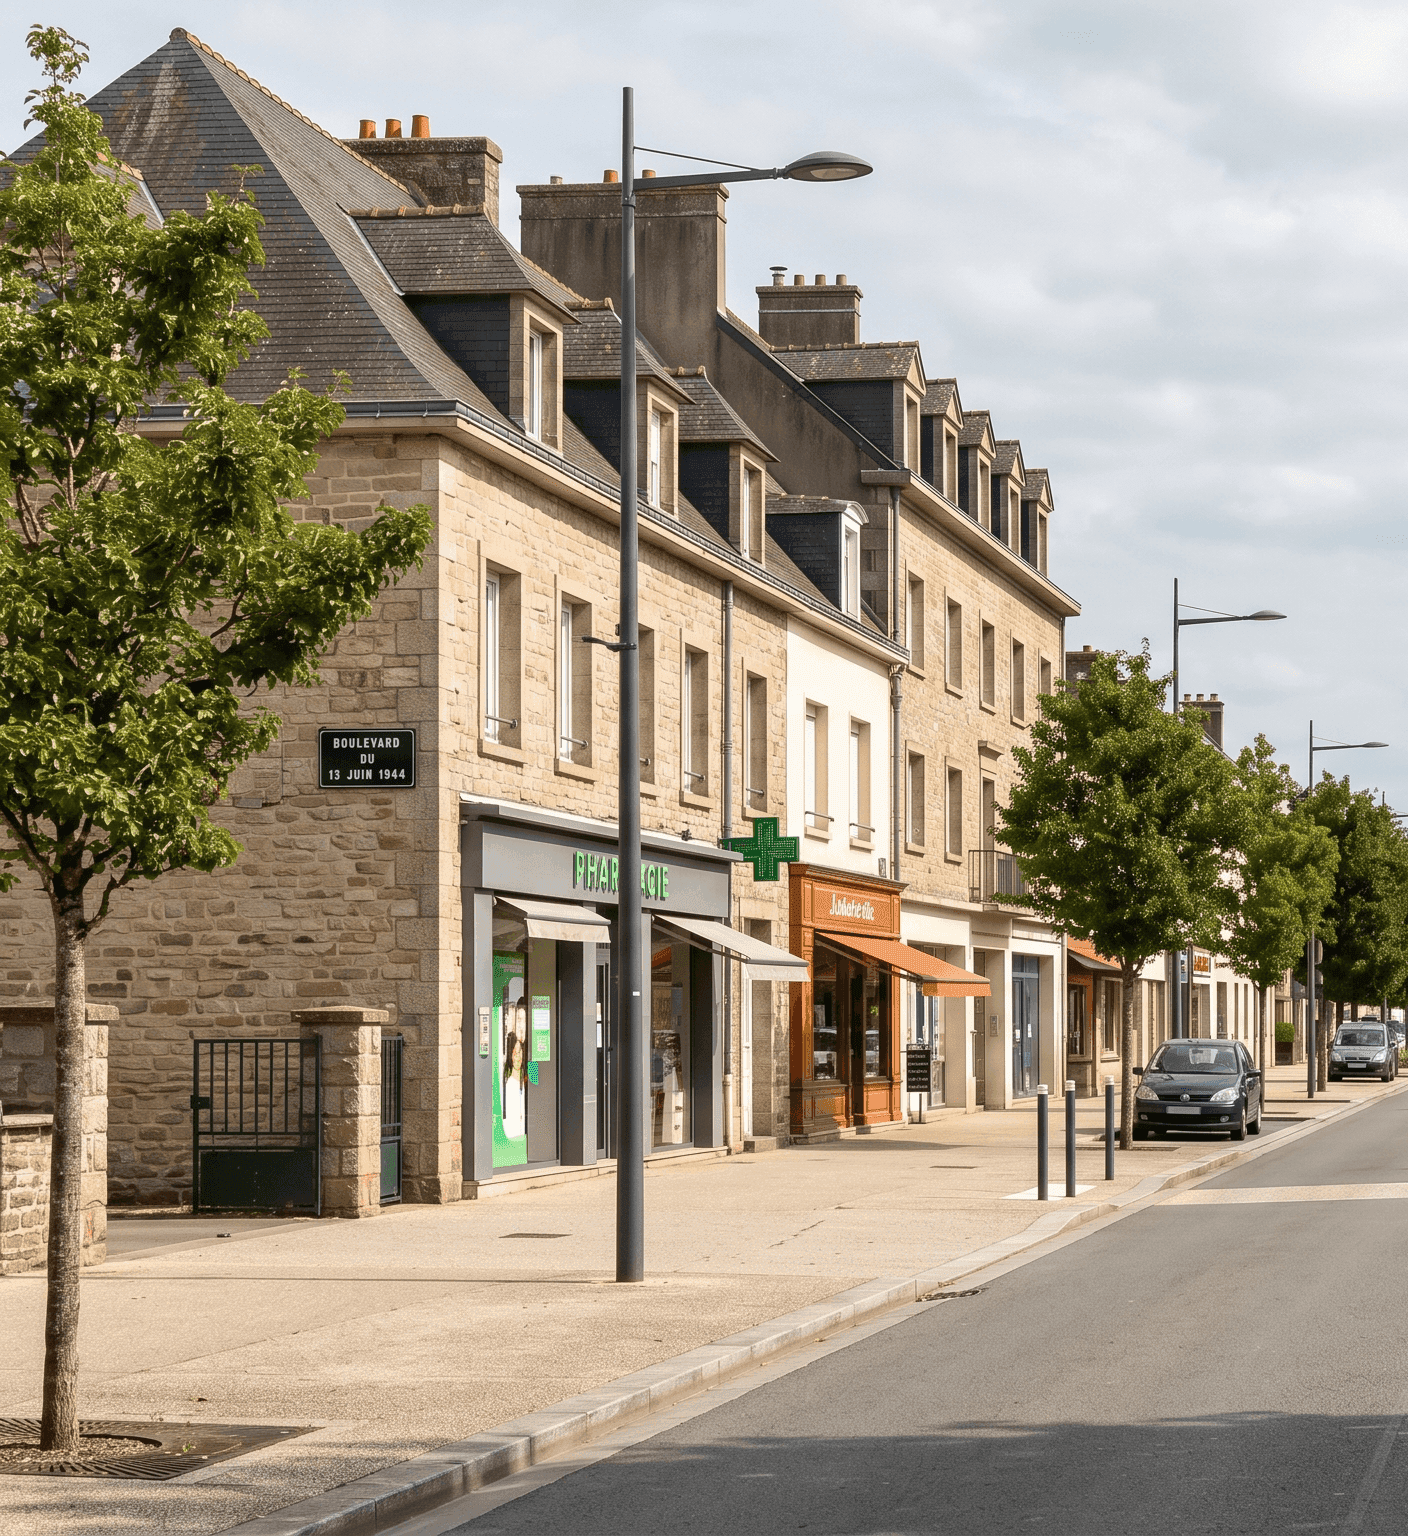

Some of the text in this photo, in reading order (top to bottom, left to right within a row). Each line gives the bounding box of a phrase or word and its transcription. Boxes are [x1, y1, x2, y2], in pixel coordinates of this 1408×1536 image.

[333, 737, 400, 749] BOULEVARD
[360, 753, 375, 765] DU
[328, 768, 406, 781] 13 JUIN 1944
[573, 850, 670, 899] PHARACIE
